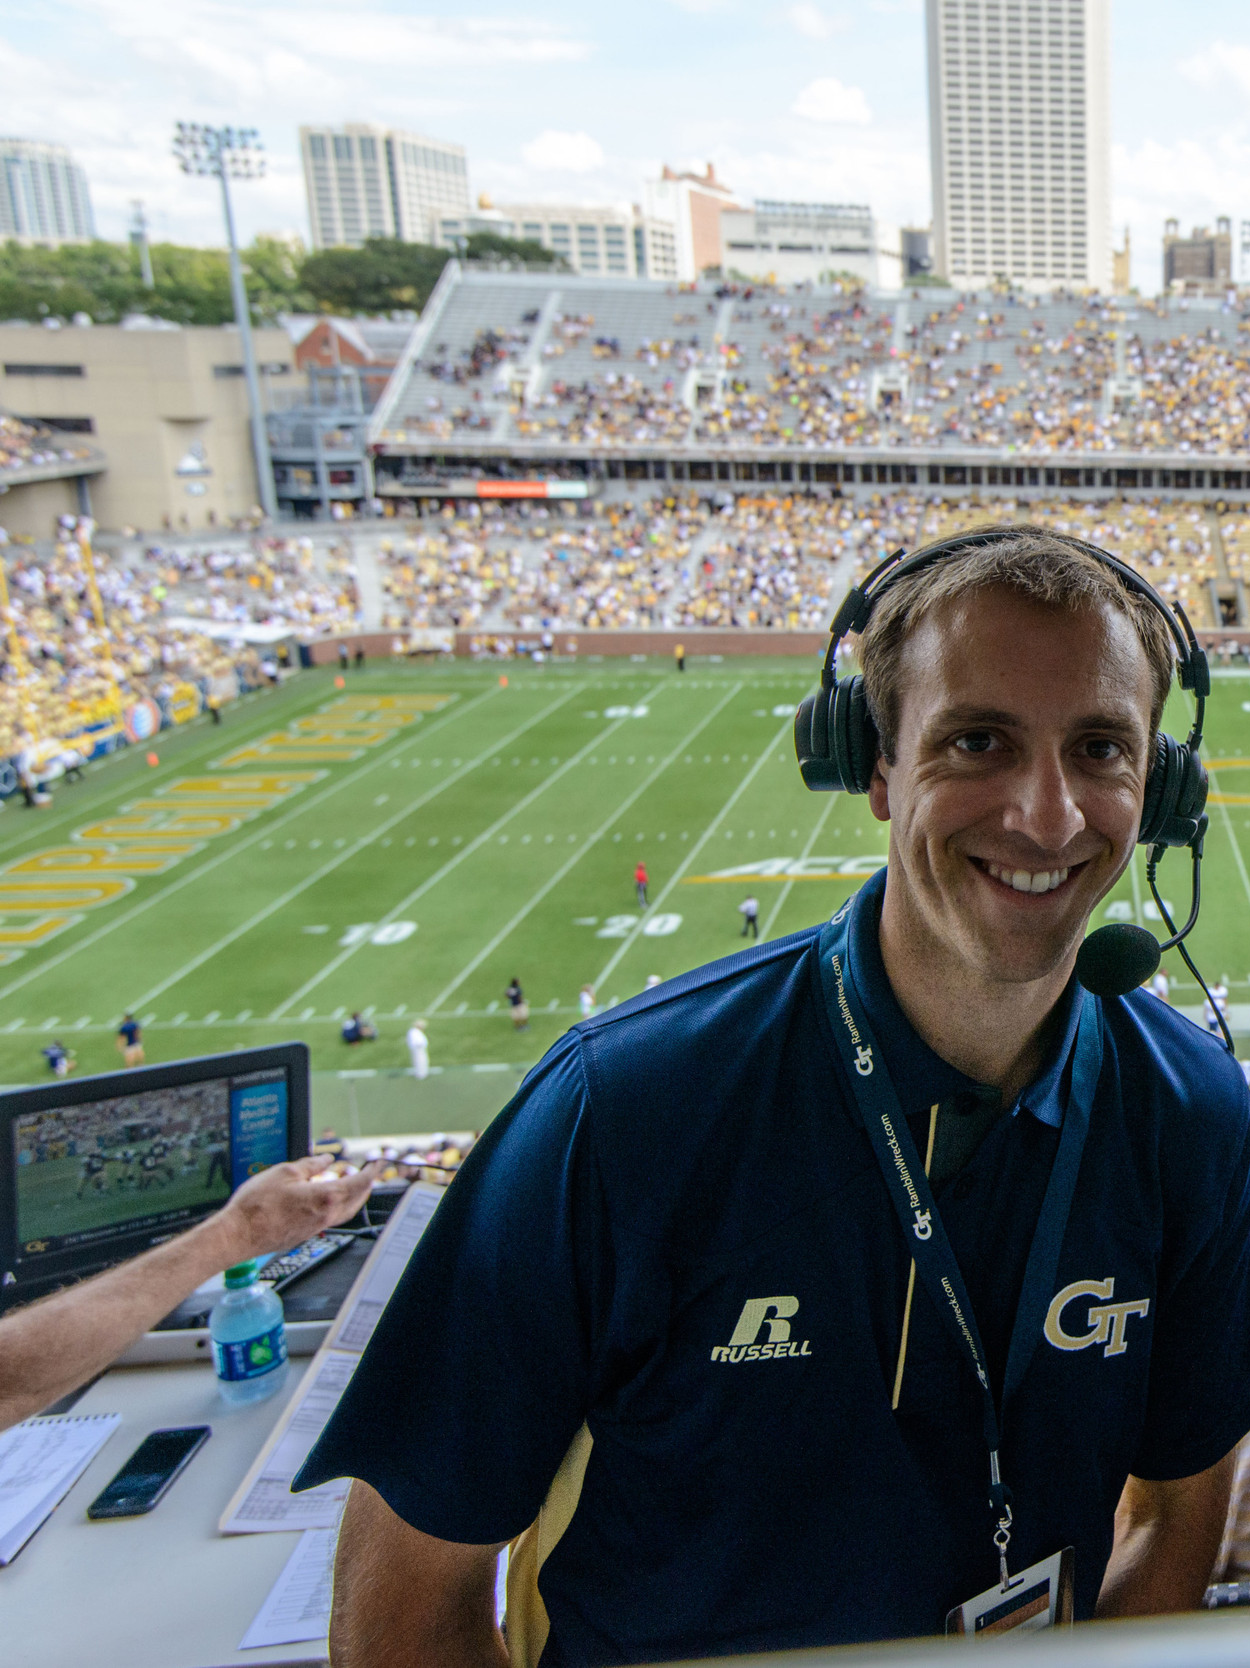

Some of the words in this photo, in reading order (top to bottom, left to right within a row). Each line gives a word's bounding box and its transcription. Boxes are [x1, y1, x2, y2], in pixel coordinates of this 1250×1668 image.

[831, 954, 862, 1045] RamblinWreck.com
[881, 1113, 920, 1208] RamblinWreck.com
[710, 1340, 812, 1363] RUSSELL
[1044, 1277, 1150, 1358] GT
